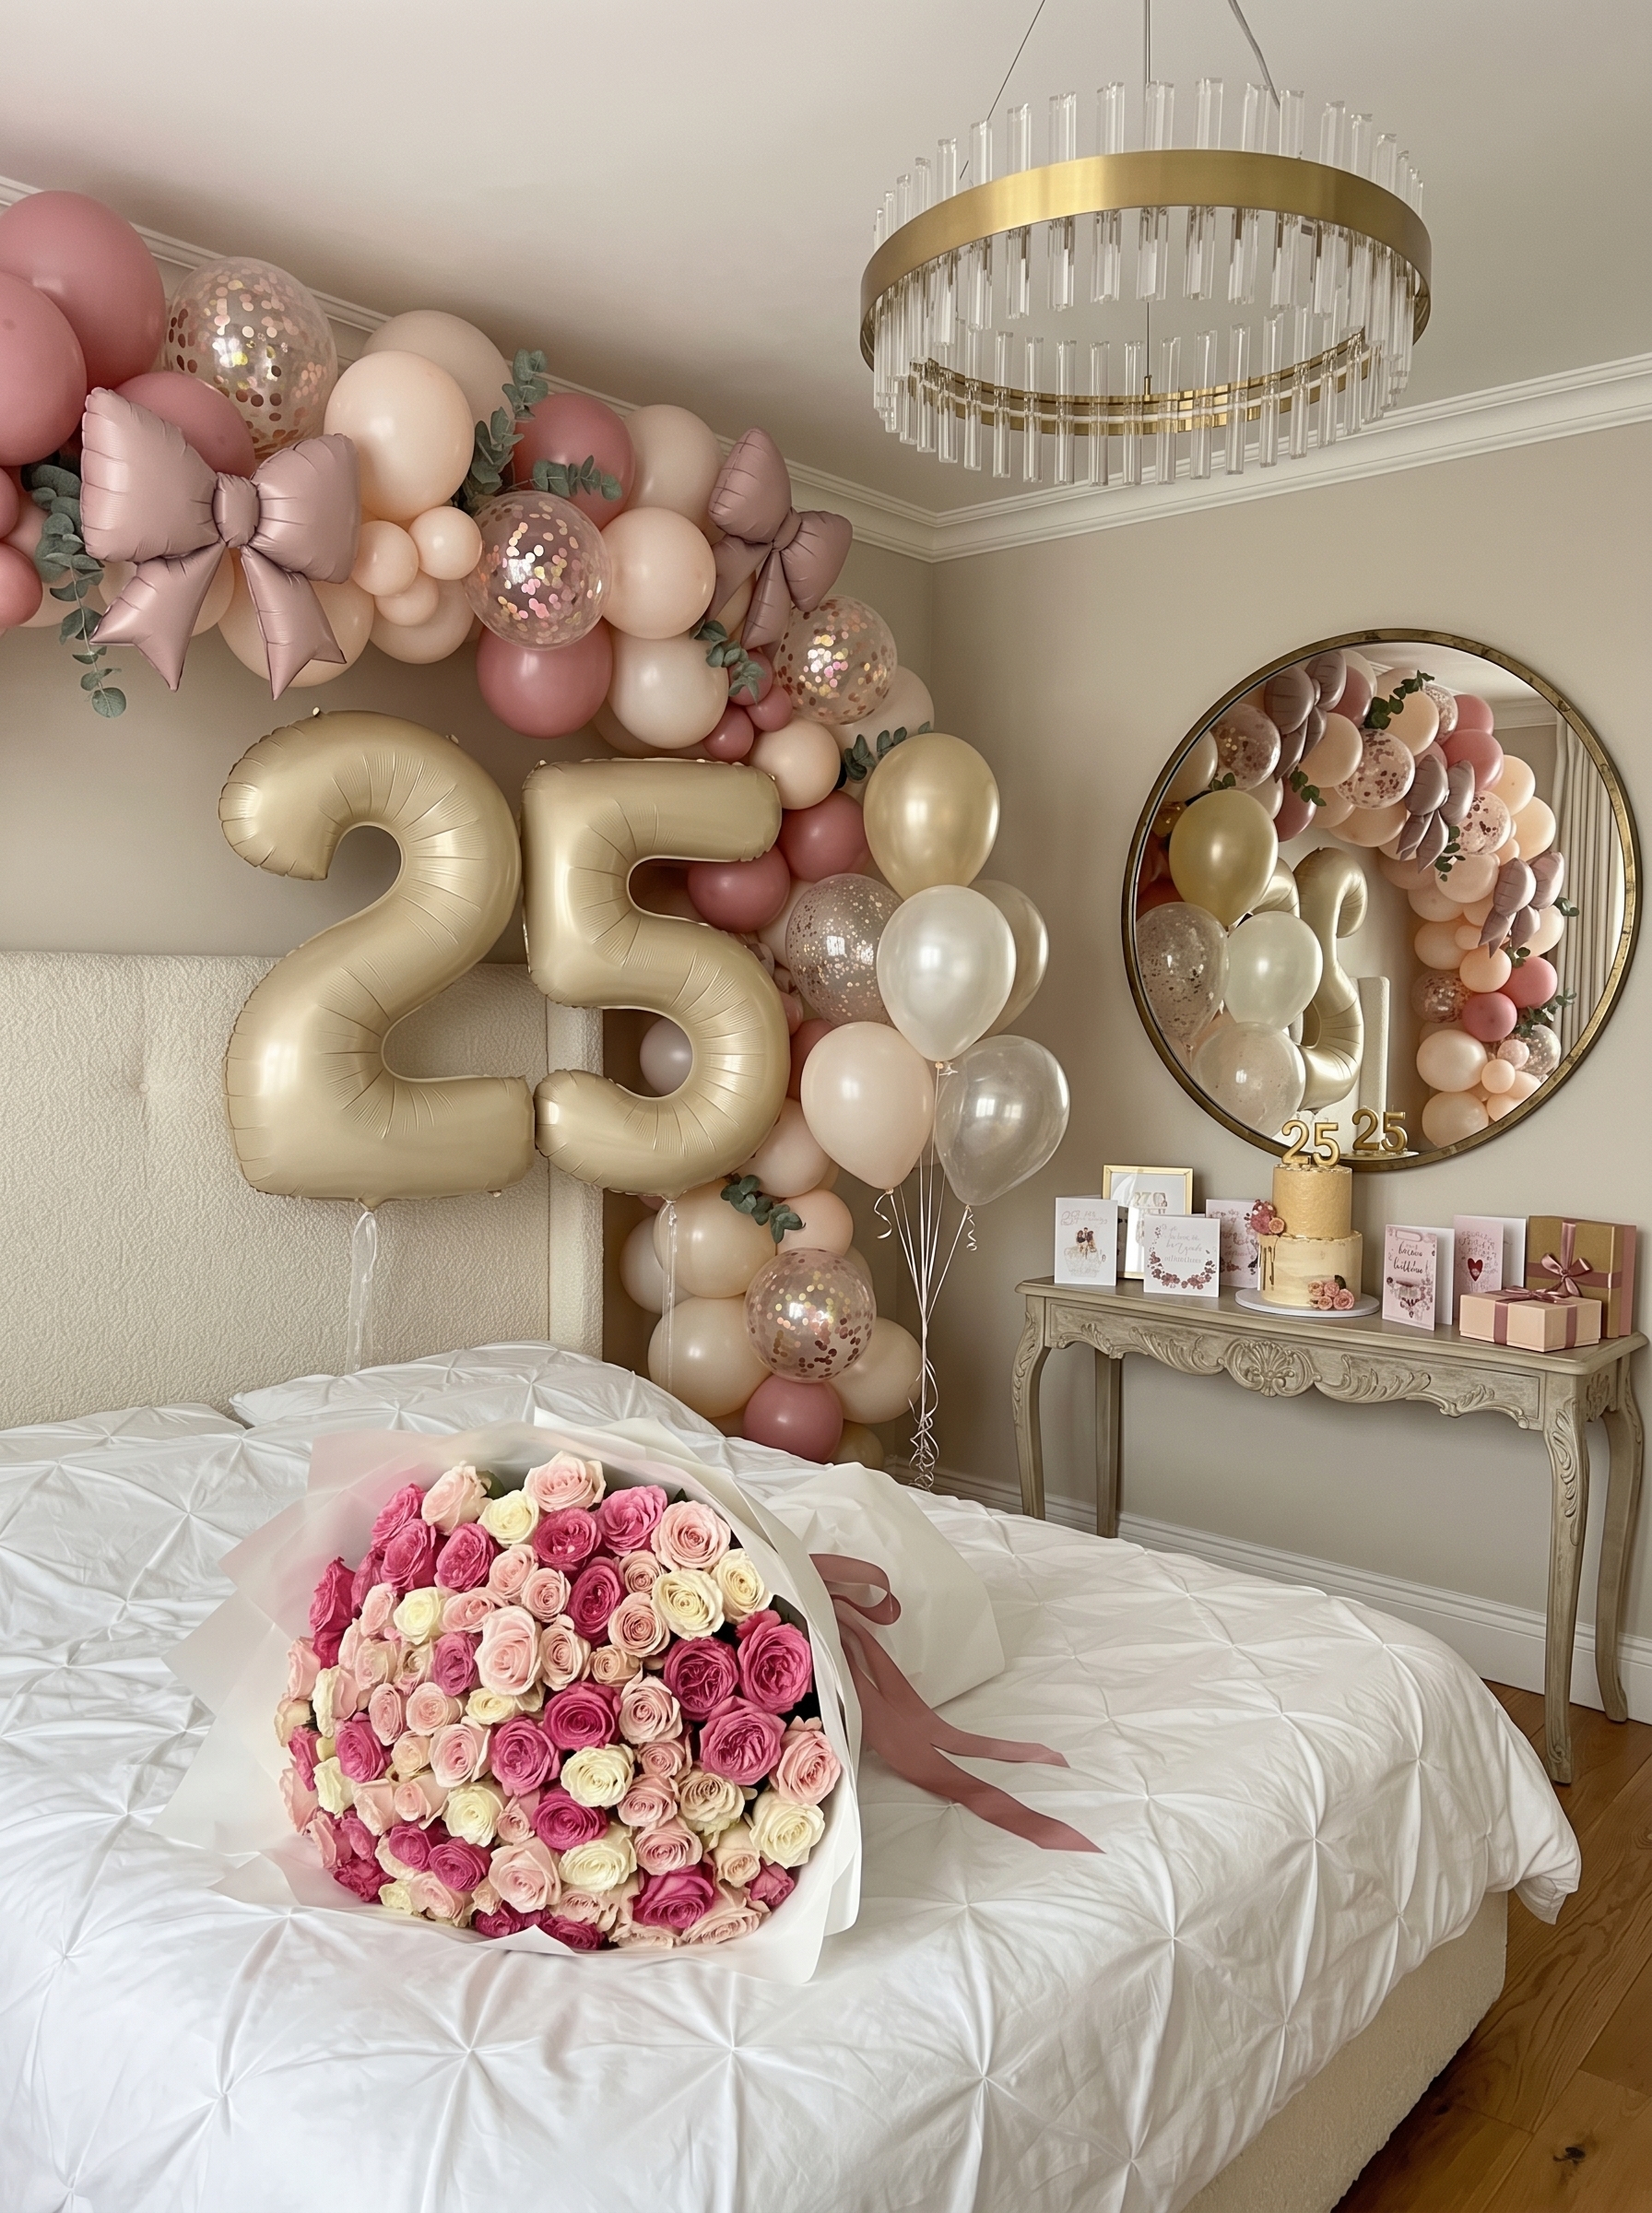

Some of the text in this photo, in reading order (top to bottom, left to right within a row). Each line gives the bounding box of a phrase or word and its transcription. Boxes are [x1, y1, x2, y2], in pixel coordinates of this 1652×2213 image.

[219, 710, 790, 1199] 25
[1281, 1119, 1340, 1166] 25
[1352, 1108, 1408, 1152] 25
